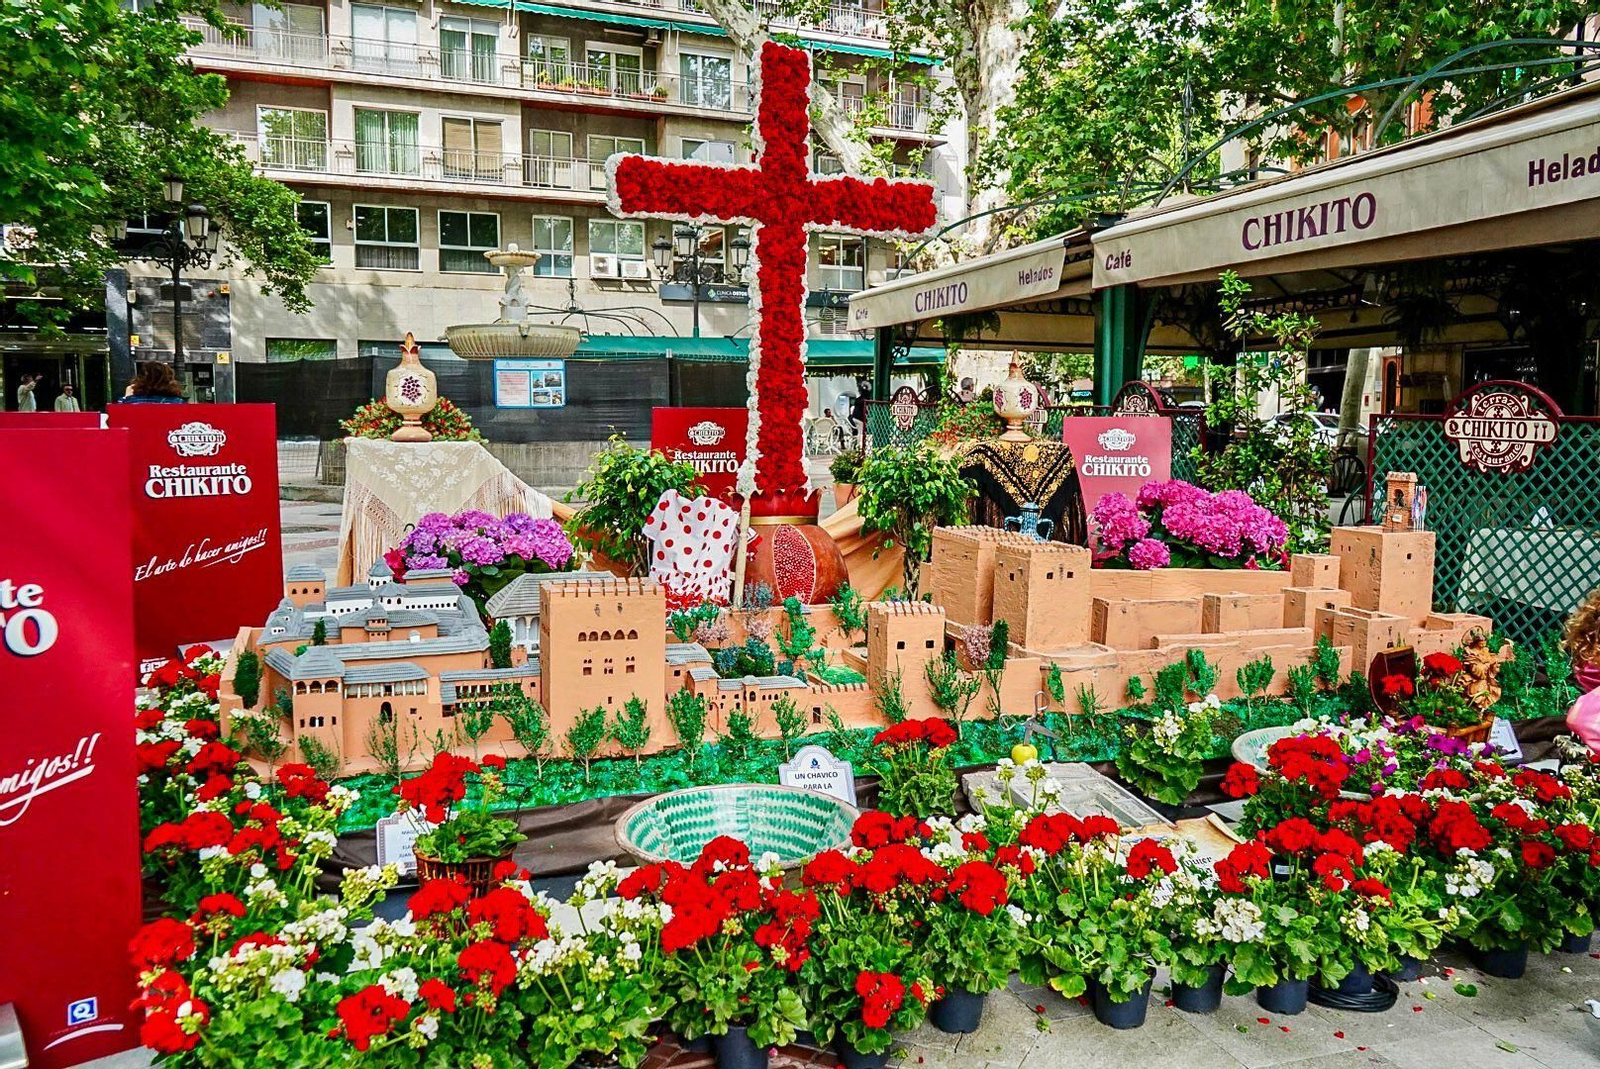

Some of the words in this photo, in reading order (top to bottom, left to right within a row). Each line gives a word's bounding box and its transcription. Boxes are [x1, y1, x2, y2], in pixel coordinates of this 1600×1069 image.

[1242, 192, 1377, 251] CHIKITO
[1105, 249, 1132, 271] Café
[1018, 266, 1053, 286] Helados
[914, 281, 968, 314] CHIKITO
[1478, 395, 1519, 414] terraza
[1462, 420, 1528, 439] CHIKITO
[674, 450, 737, 460] Restaurante
[1084, 454, 1149, 464] Restaurante
[1472, 443, 1522, 465] restaurante
[150, 462, 246, 477] Restaurante
[1081, 463, 1152, 477] CHIKITO
[145, 475, 252, 499] CHIKITO
[134, 556, 158, 581] El
[154, 559, 178, 576] arte
[178, 544, 196, 568] de
[194, 538, 223, 562] hacer
[224, 528, 267, 563] amigos!!
